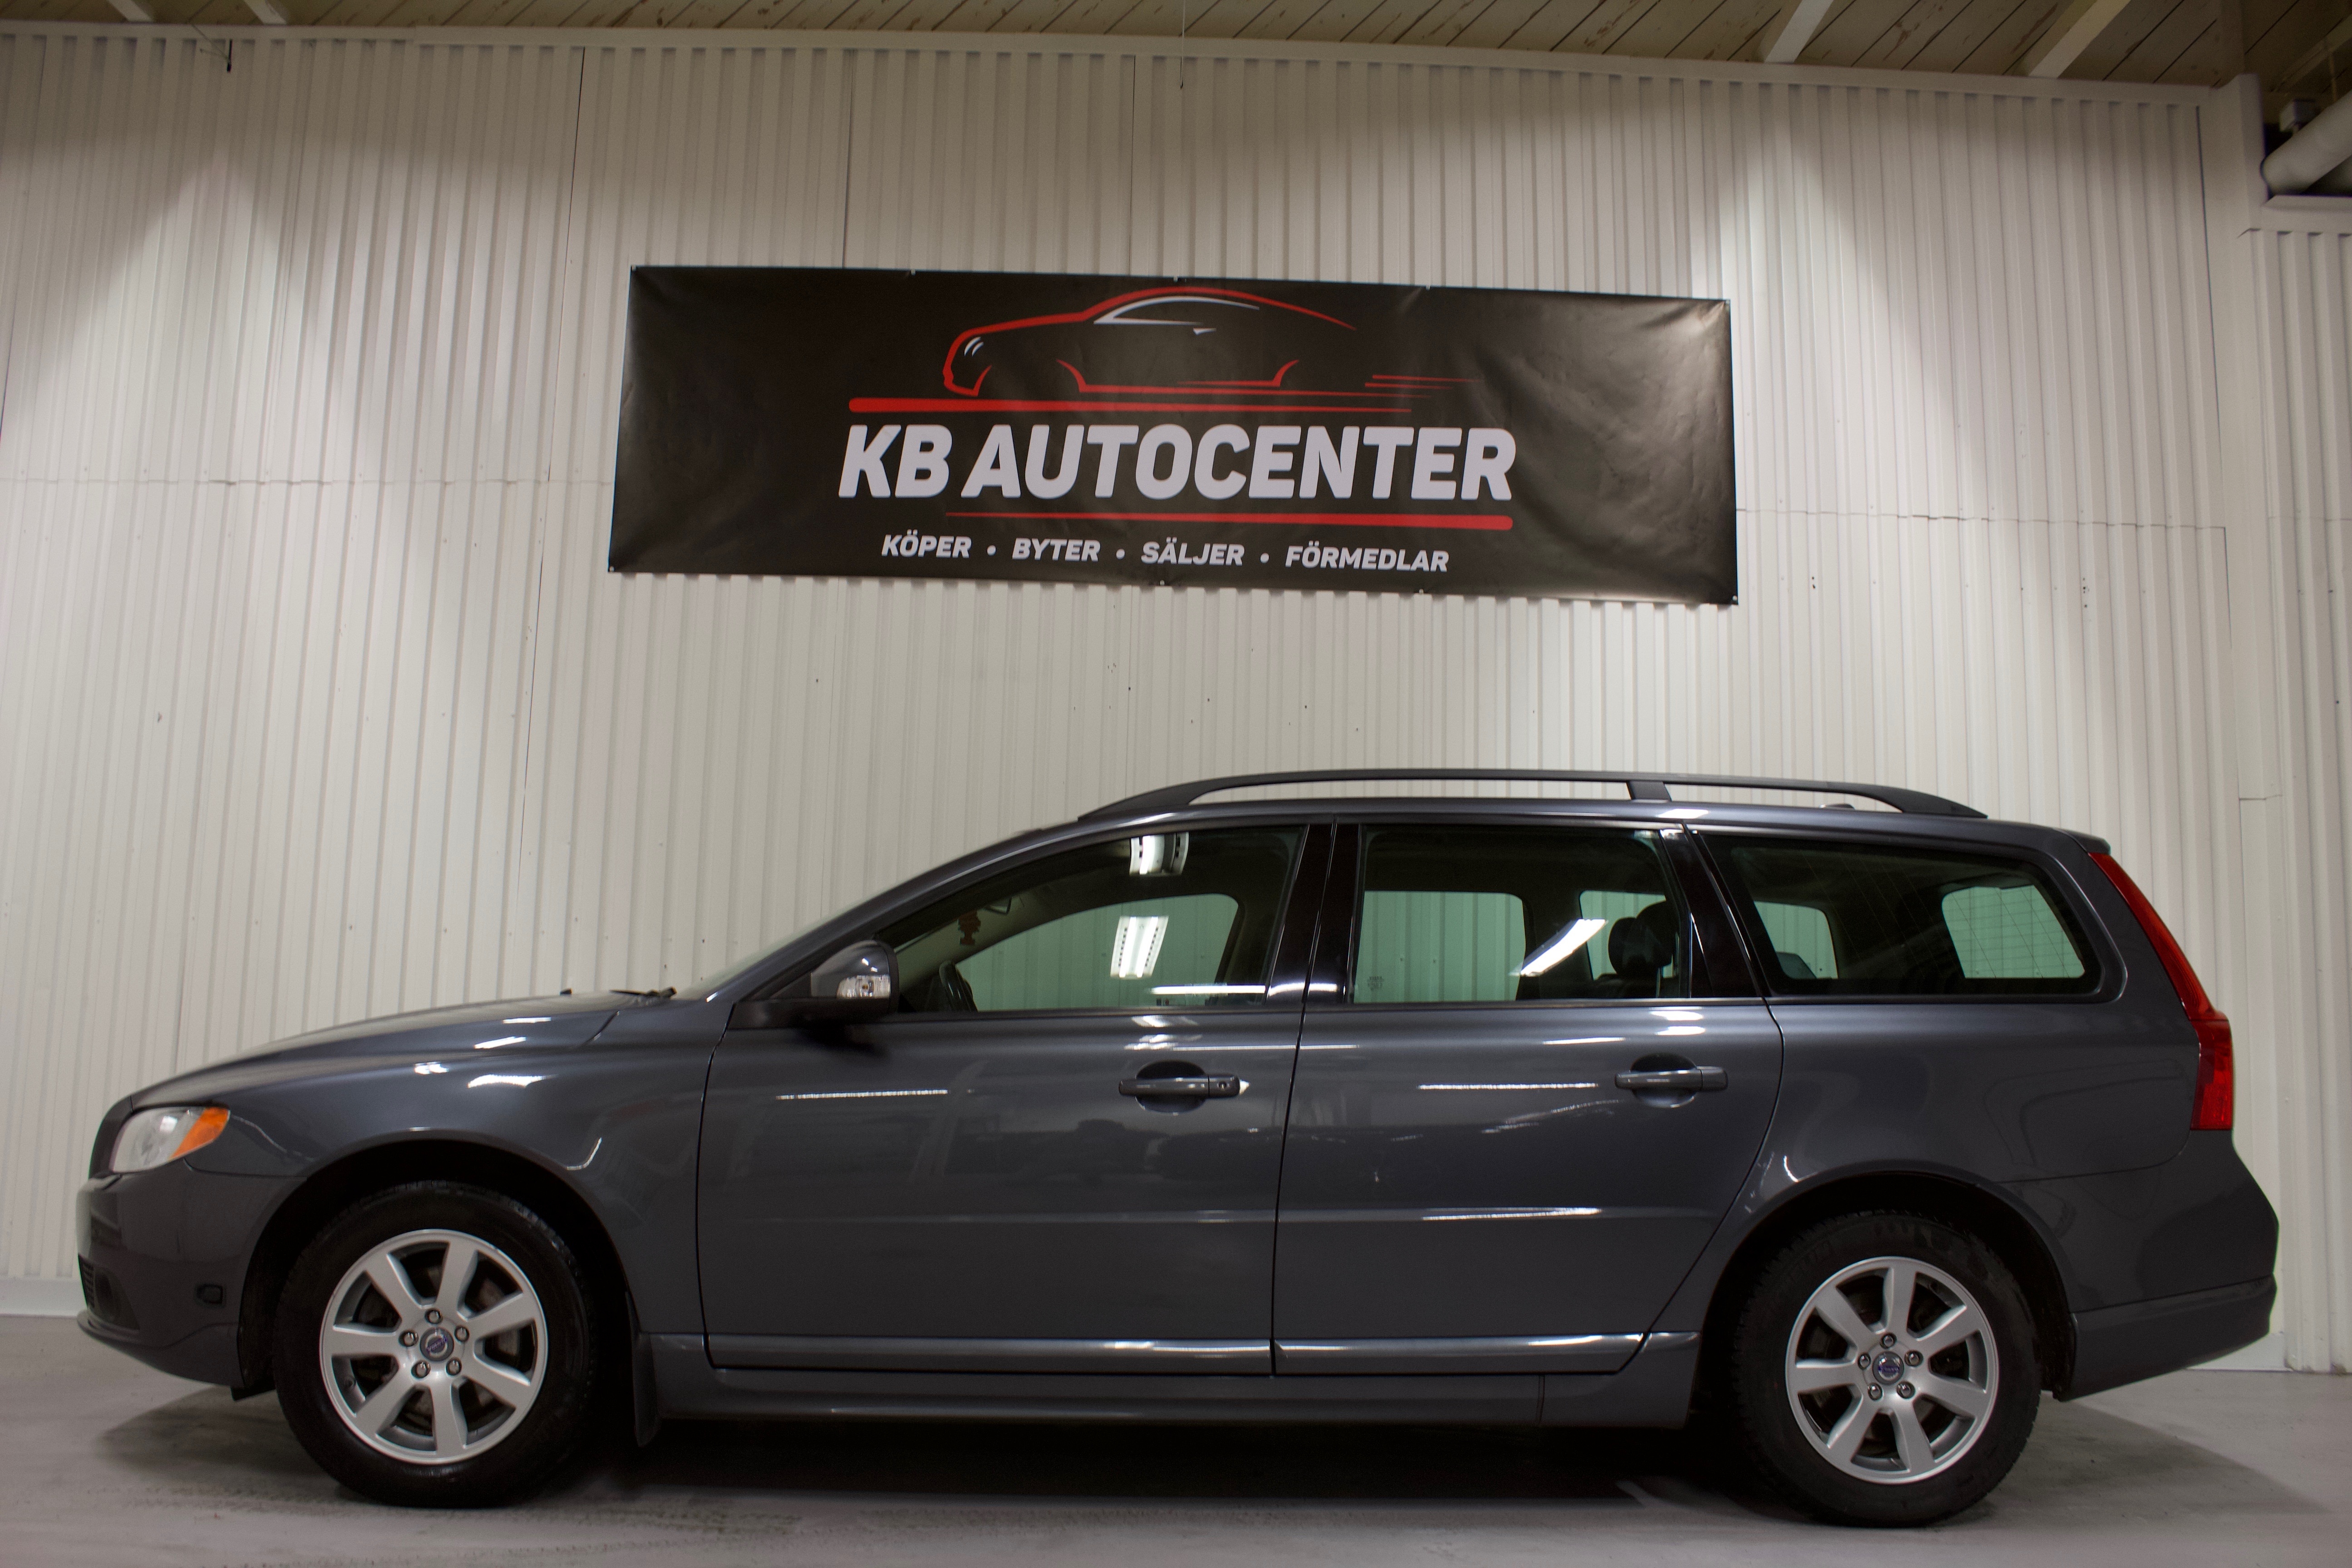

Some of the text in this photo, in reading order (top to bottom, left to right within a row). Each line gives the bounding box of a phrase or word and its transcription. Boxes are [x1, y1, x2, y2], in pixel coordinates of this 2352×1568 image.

[838, 424, 1517, 500] KB AUTOCENTER
[881, 529, 1450, 572] KÖPER BYTER SÄLJER FÖRMEDLAR
